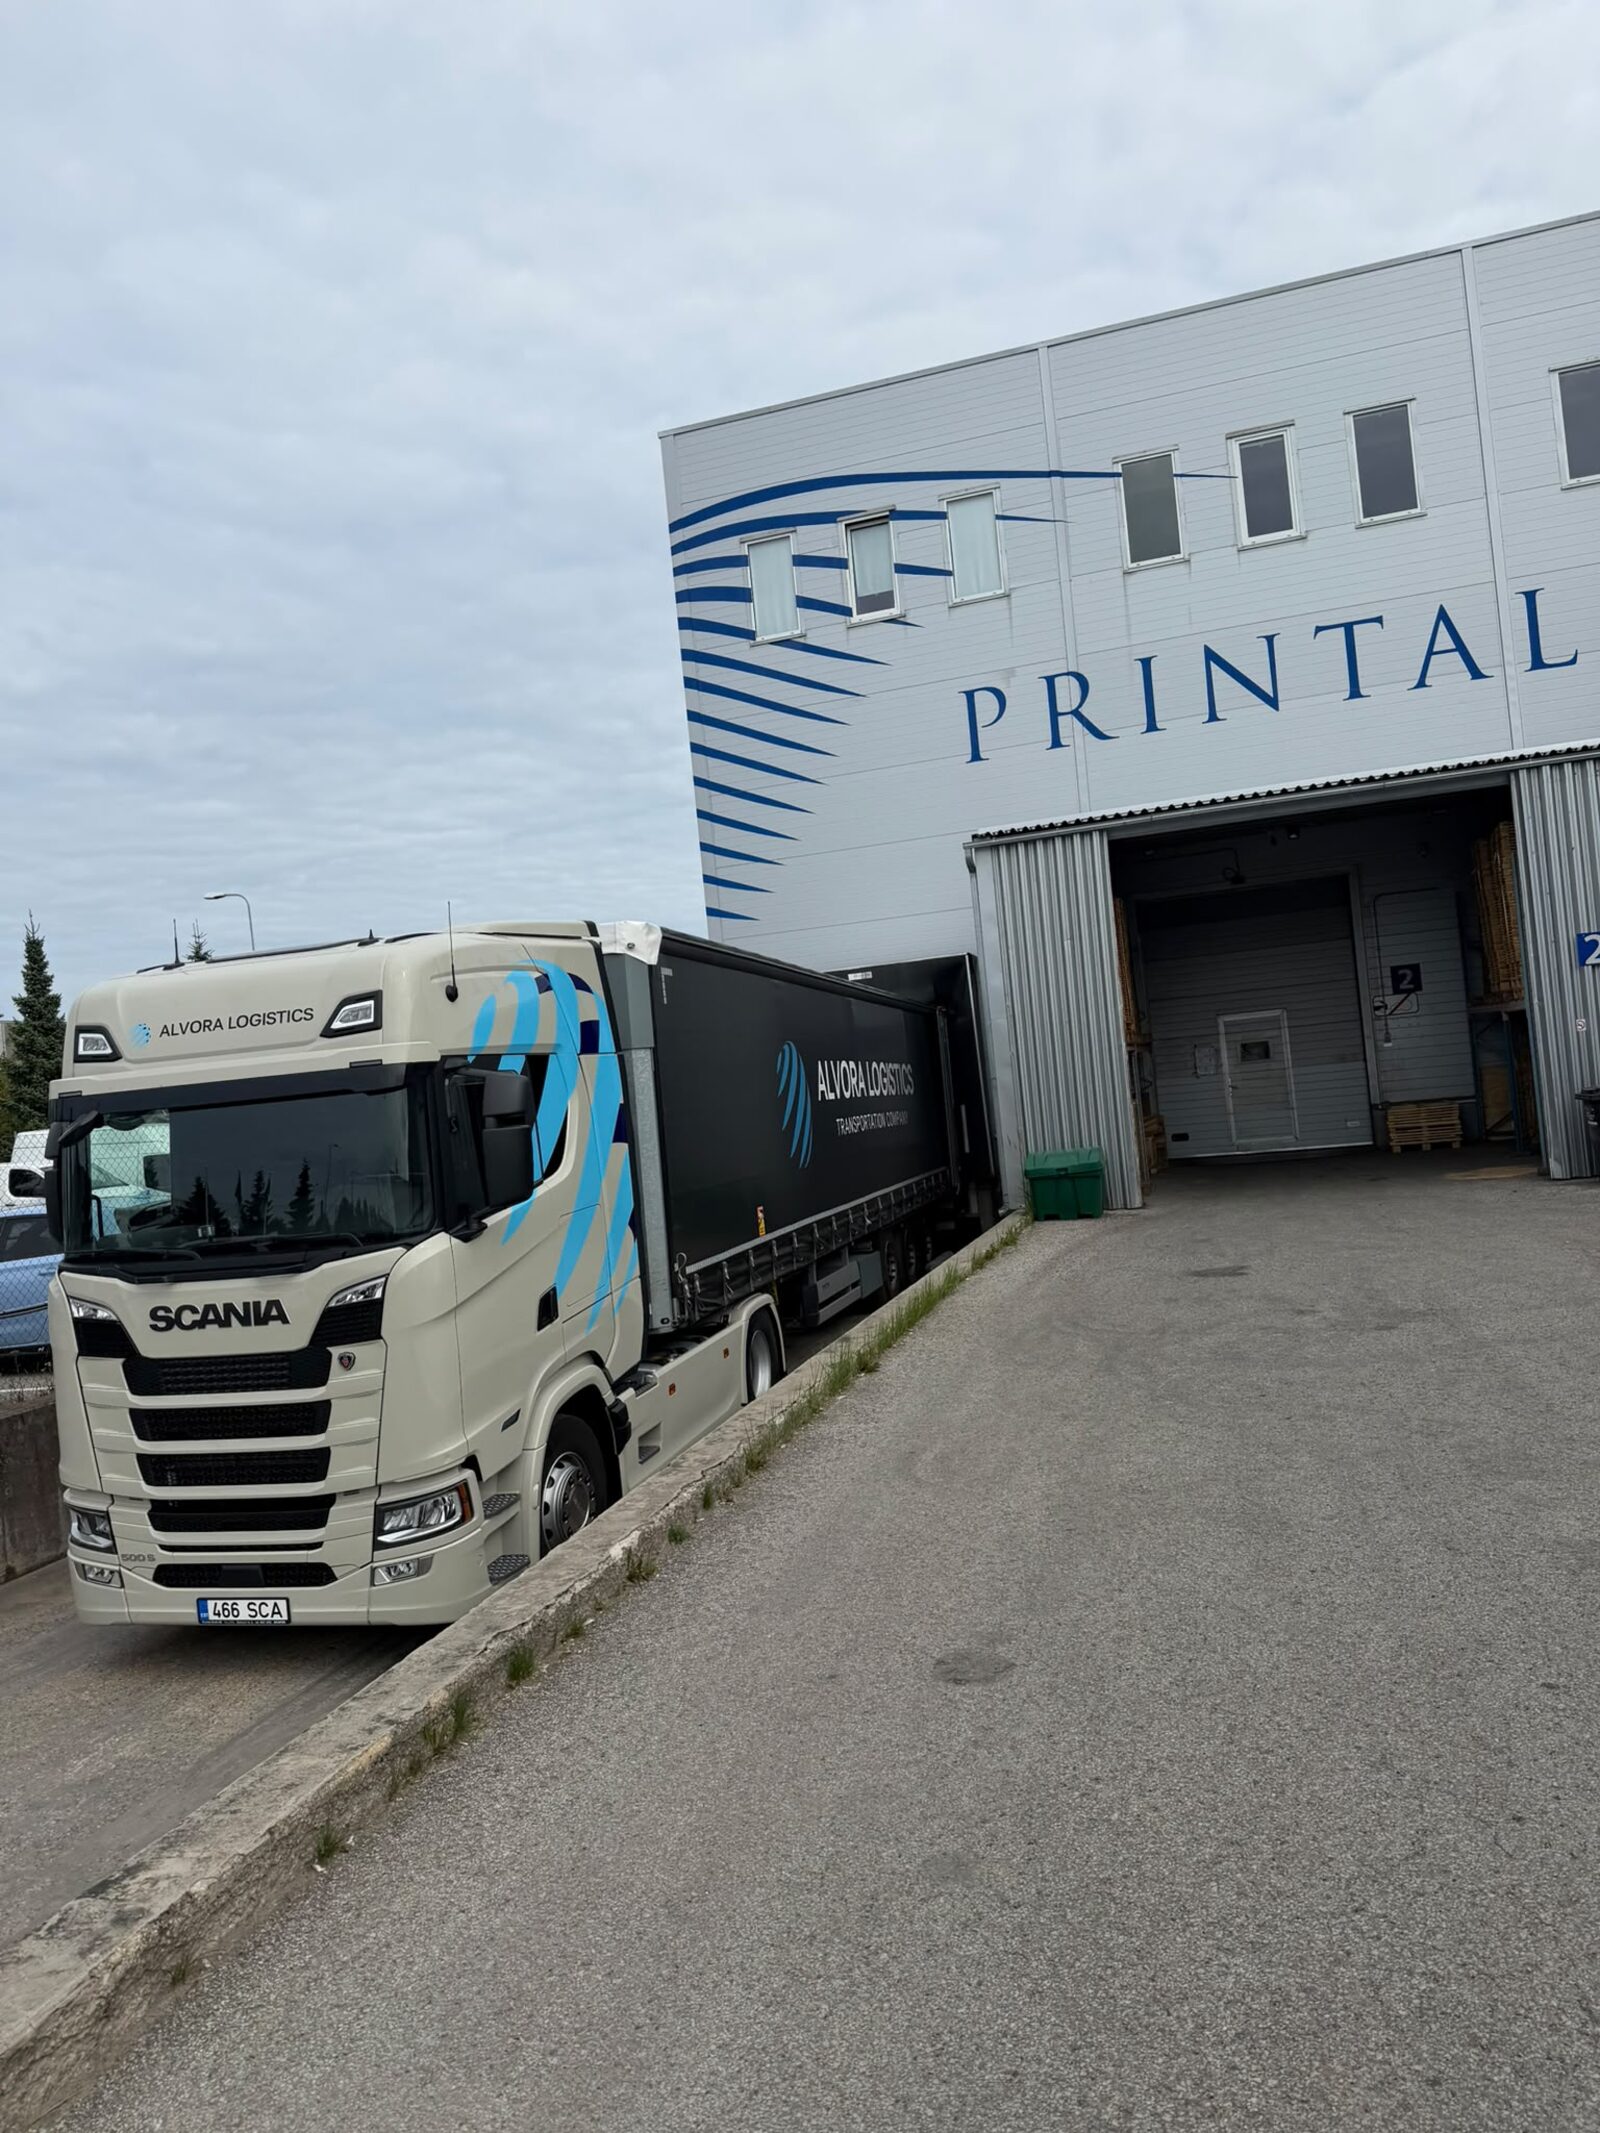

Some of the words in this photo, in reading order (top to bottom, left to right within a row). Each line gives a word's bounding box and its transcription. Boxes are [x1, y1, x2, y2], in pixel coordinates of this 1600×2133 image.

[958, 587, 1579, 764] PRINTAL
[1583, 934, 1600, 965] 2
[1397, 969, 1415, 989] 2
[159, 1018, 224, 1037] ALVORA
[228, 1007, 314, 1030] LOGISTICS
[817, 1060, 868, 1101] ALVORA
[866, 1060, 915, 1097] LOGISTICS
[836, 1112, 886, 1136] TRANSPORTATION
[149, 1299, 290, 1332] SCANIA
[212, 1602, 240, 1618] 466
[246, 1602, 283, 1618] SCA
